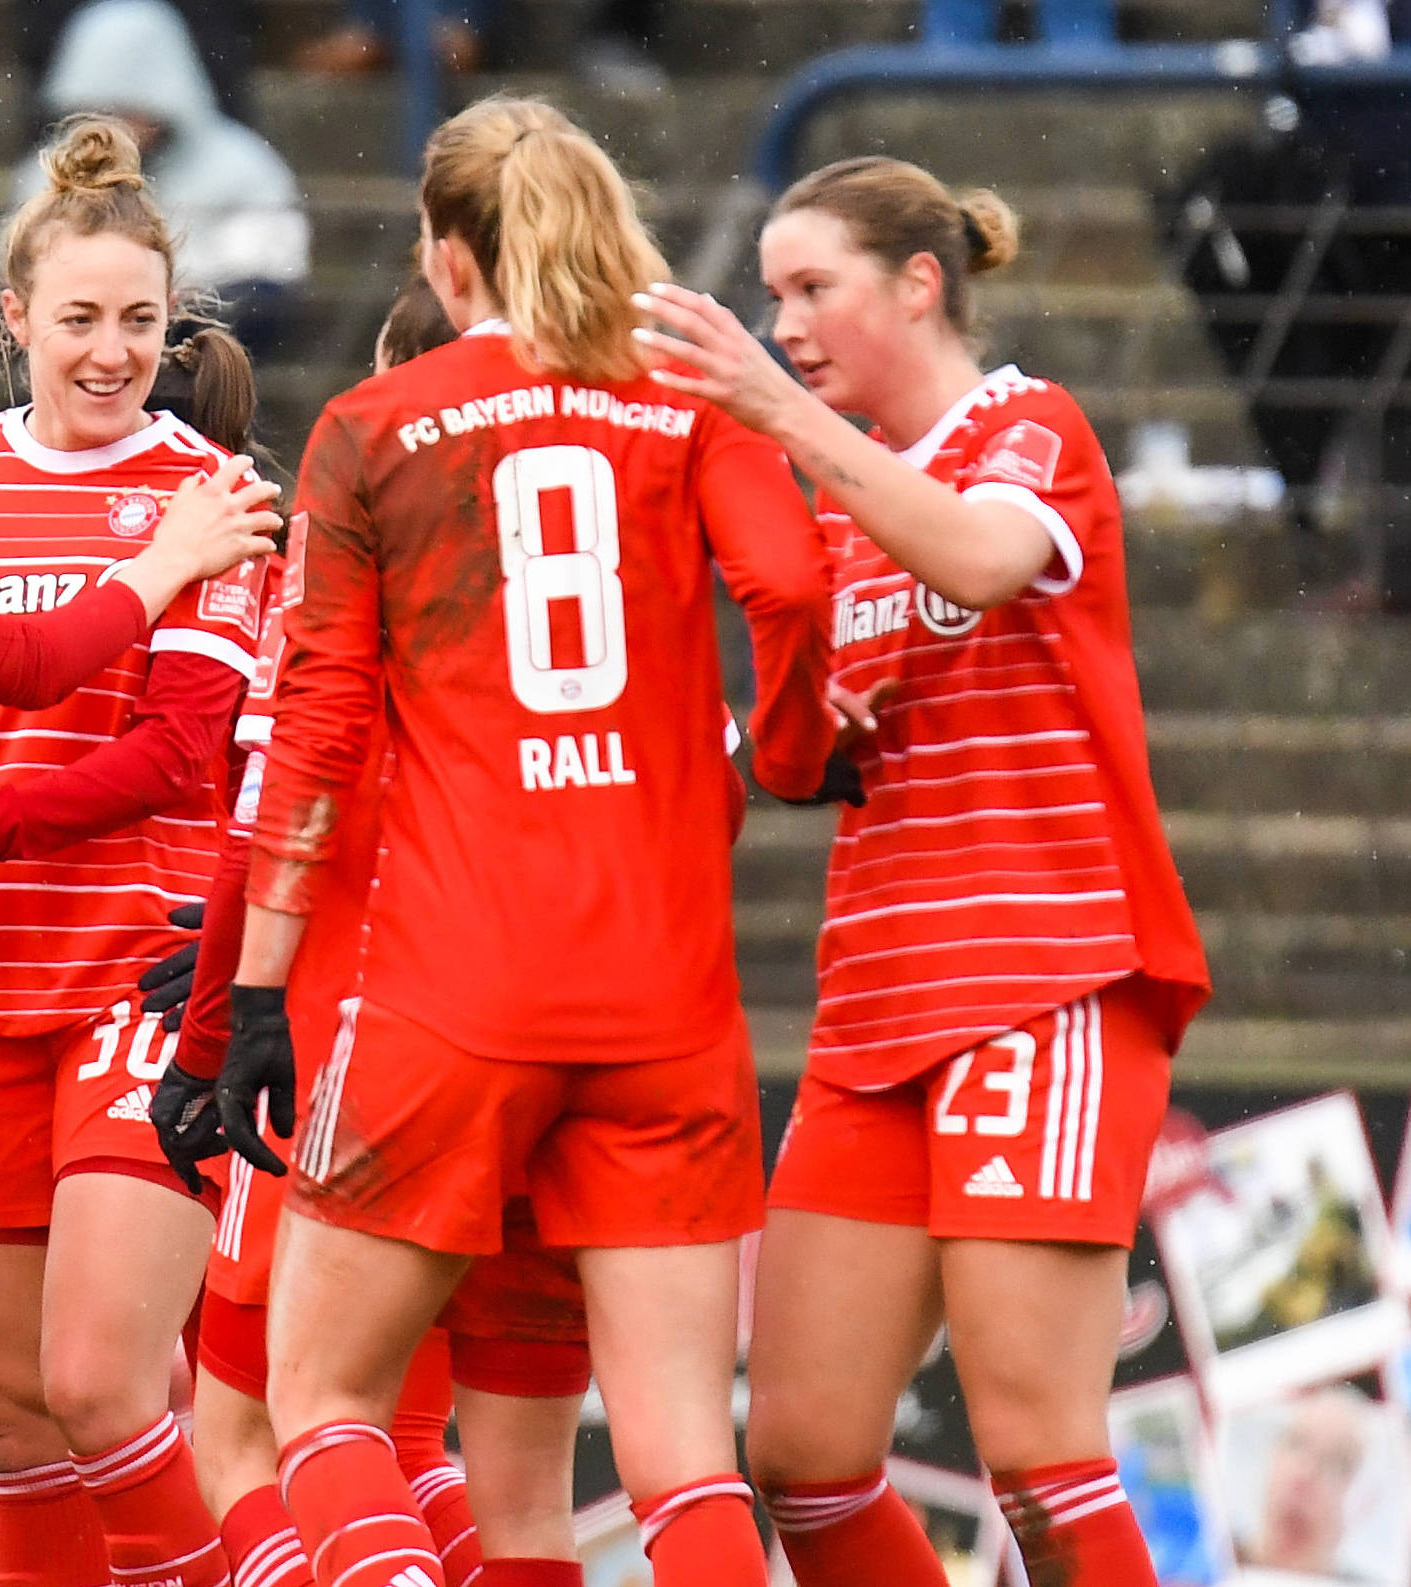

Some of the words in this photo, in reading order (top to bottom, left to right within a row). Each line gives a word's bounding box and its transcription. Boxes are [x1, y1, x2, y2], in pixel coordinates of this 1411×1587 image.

[397, 415, 440, 453] FC
[440, 384, 555, 436] BAYERN
[493, 445, 628, 714] 8
[519, 731, 636, 791] RALL
